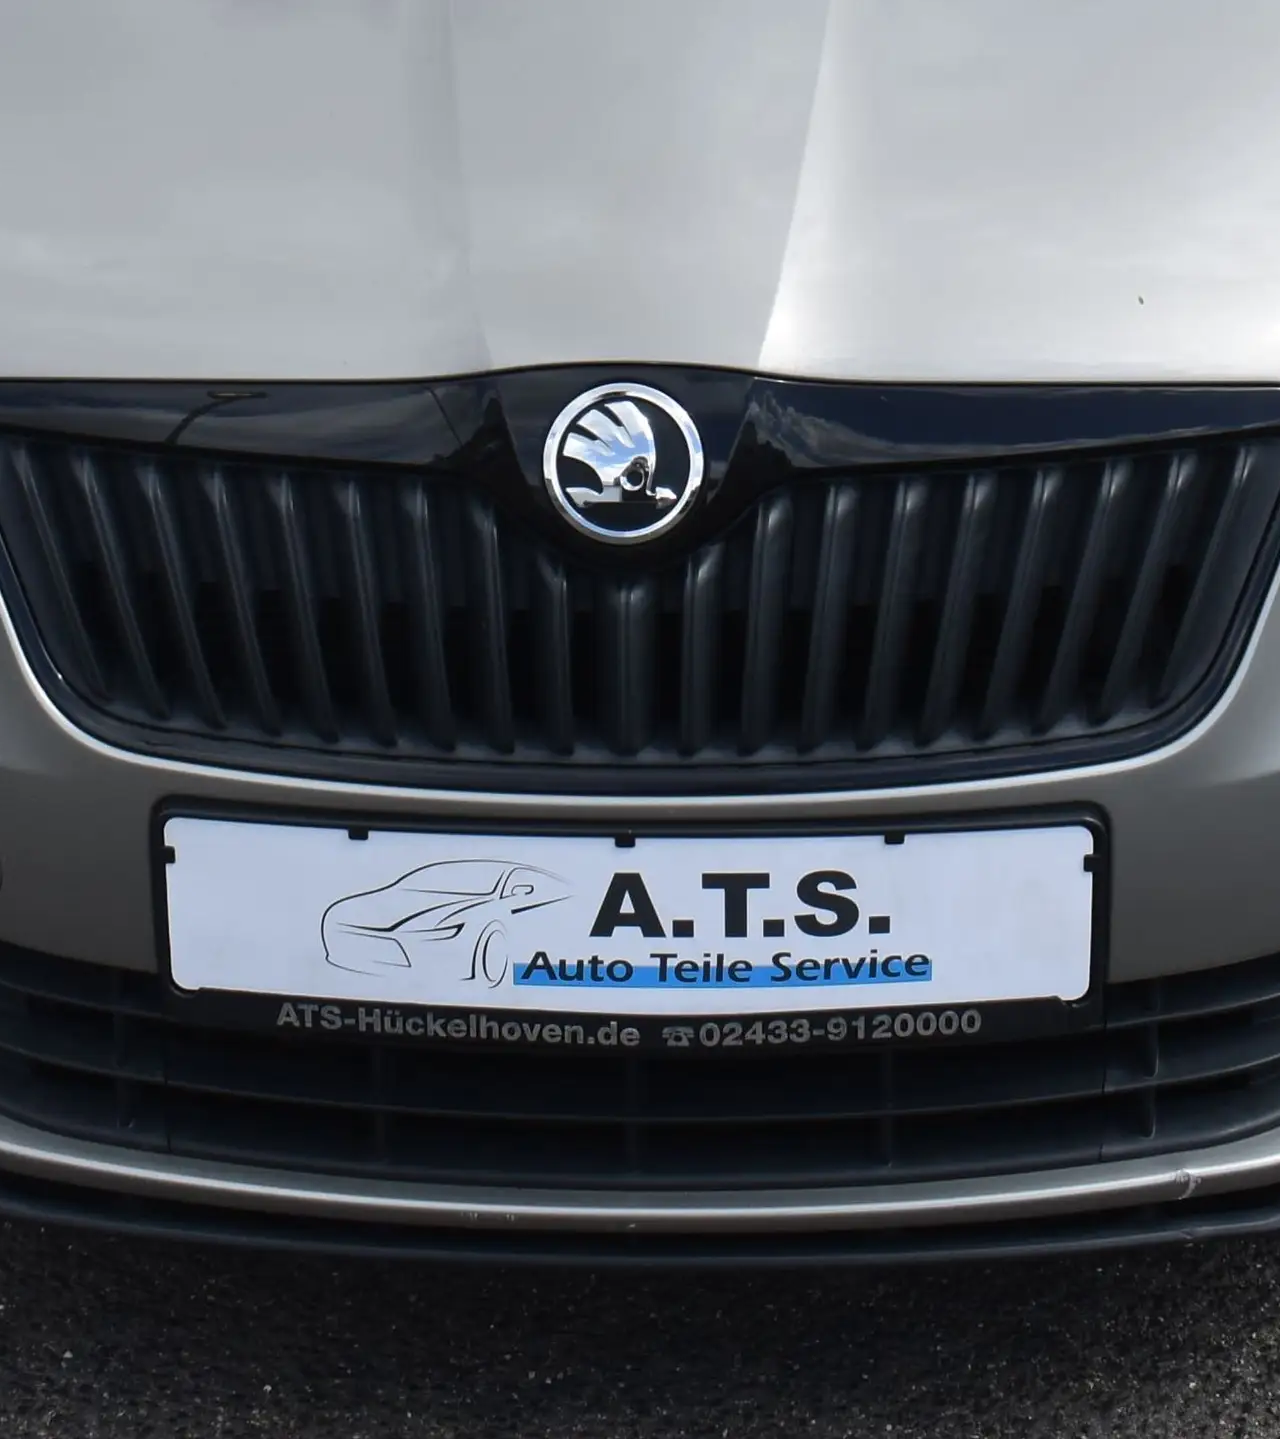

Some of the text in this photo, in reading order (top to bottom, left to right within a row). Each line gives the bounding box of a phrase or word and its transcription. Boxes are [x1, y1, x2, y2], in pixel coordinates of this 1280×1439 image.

[588, 869, 892, 938] A.T.S.
[520, 948, 932, 984] Auto Teile Service
[275, 1000, 983, 1048] ATS-Hückelhoven.de 02433-9120000
